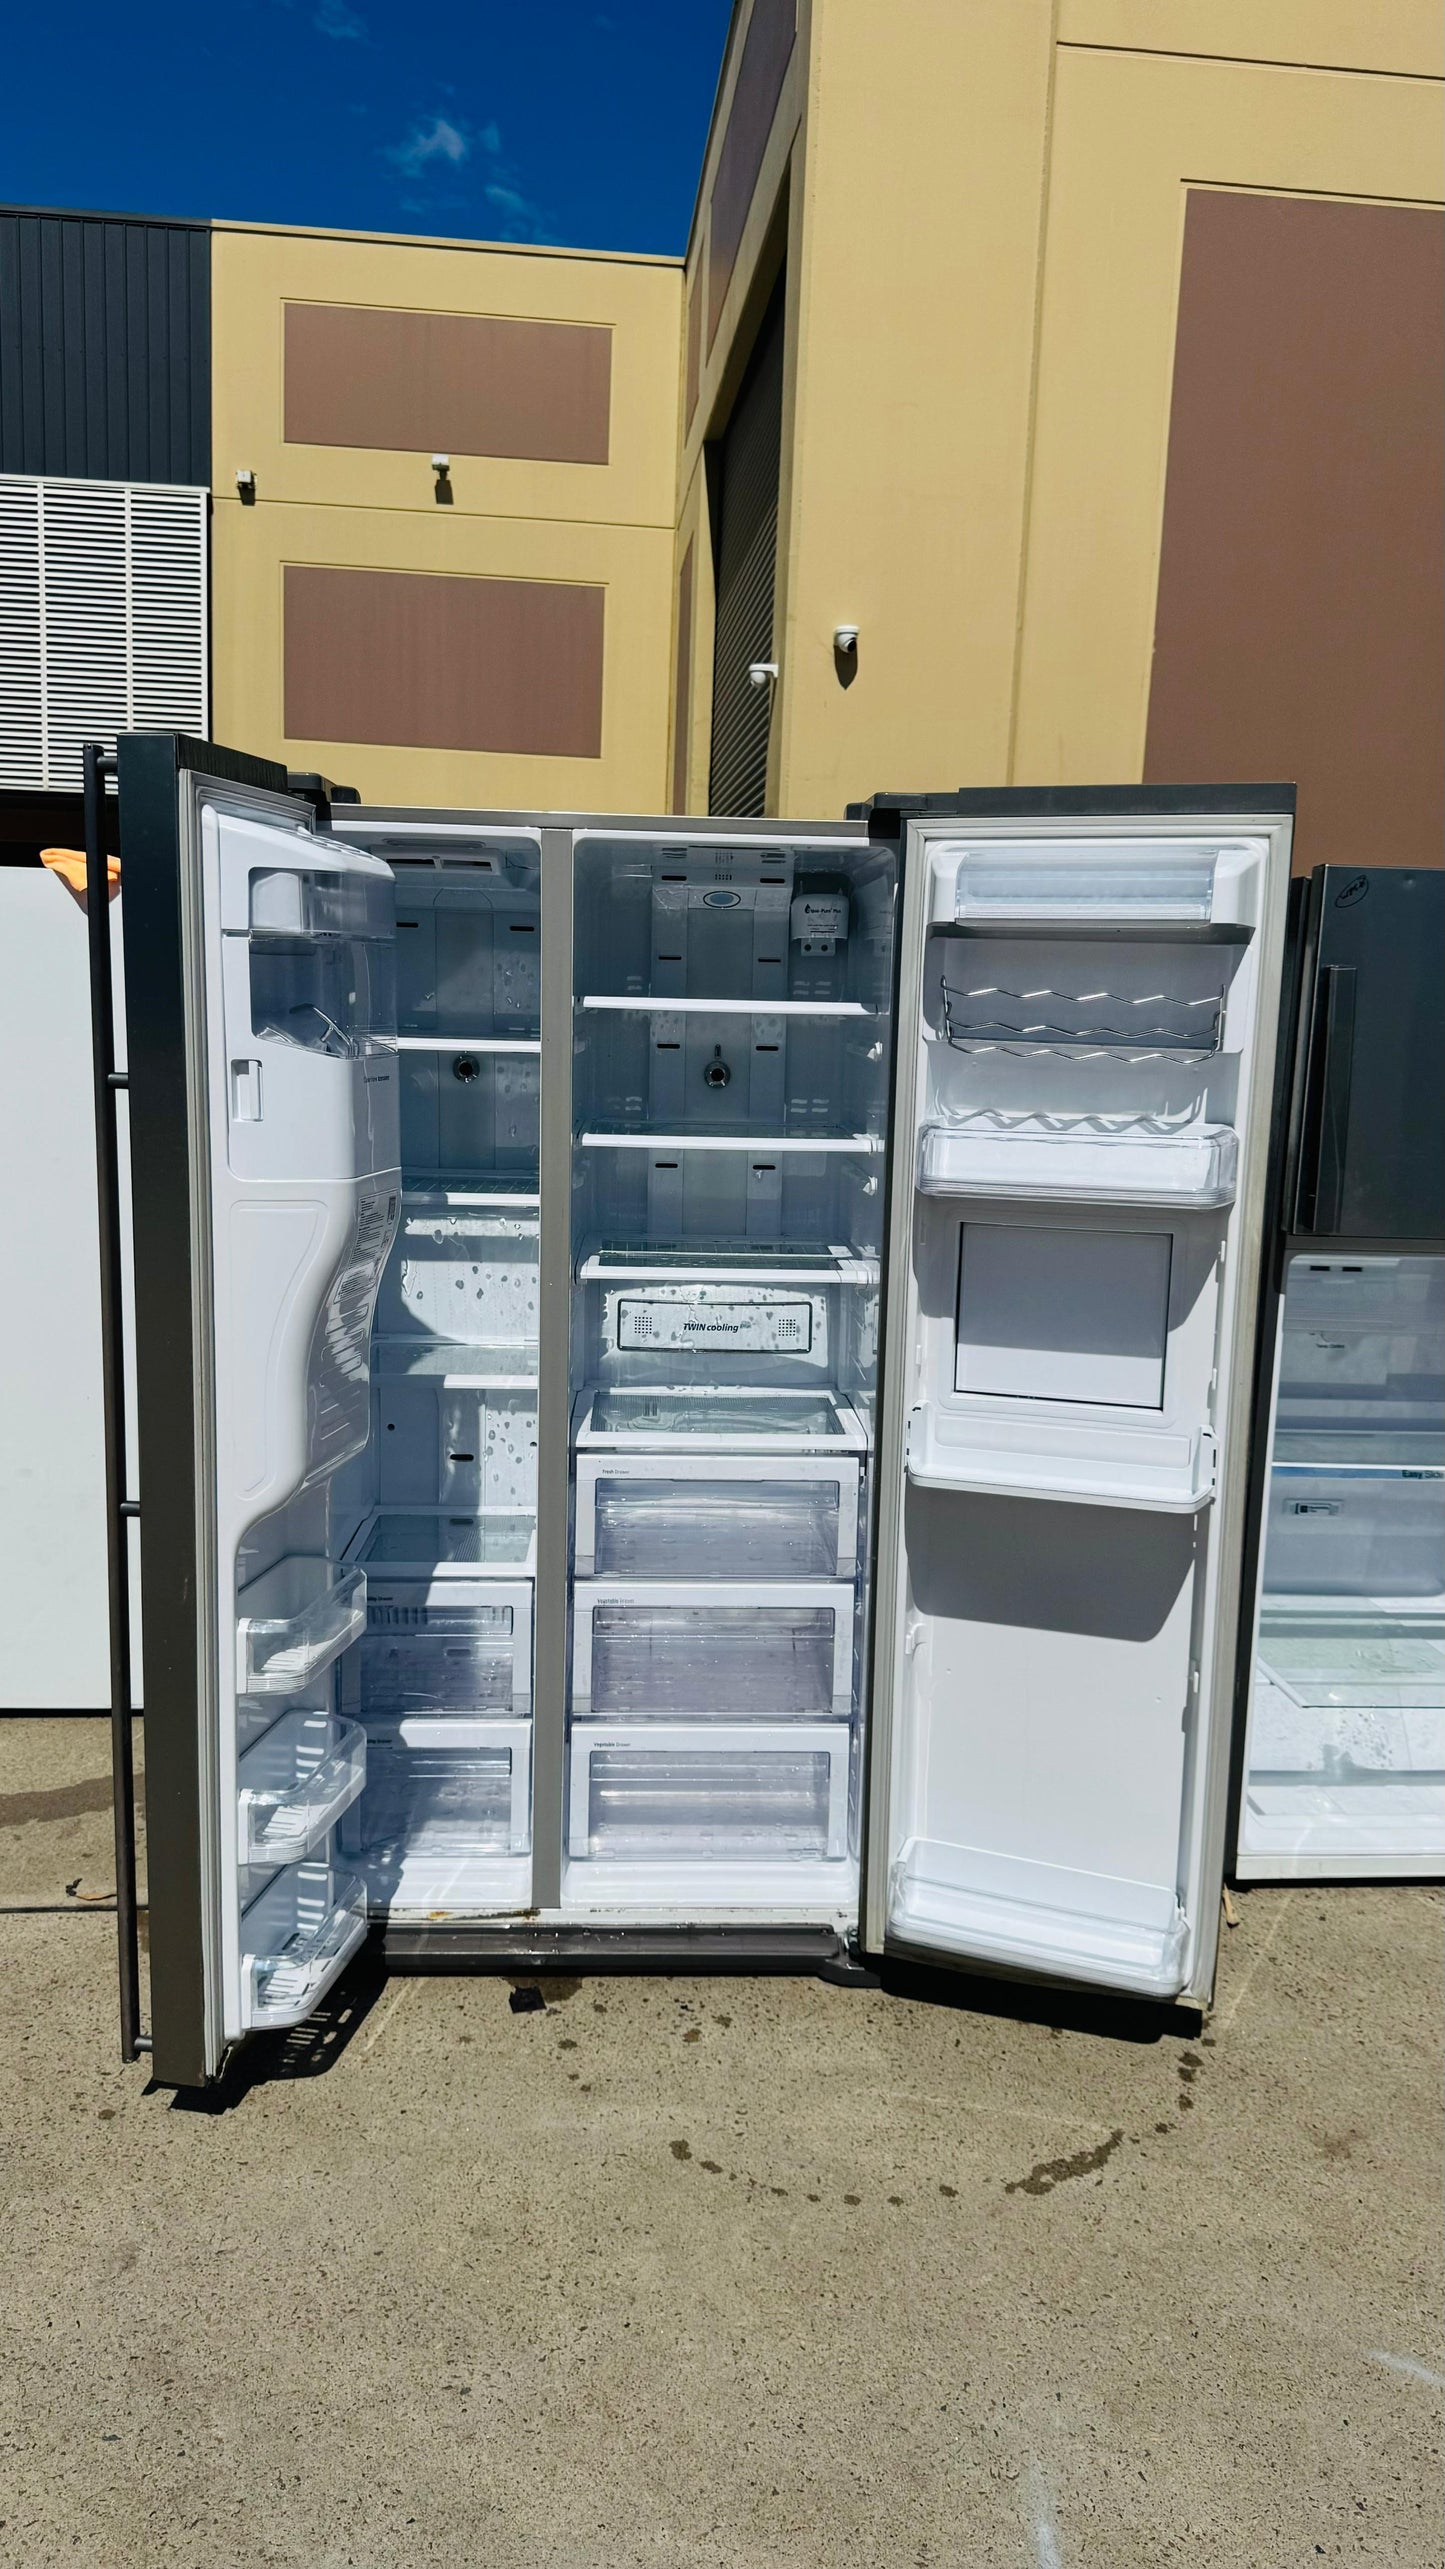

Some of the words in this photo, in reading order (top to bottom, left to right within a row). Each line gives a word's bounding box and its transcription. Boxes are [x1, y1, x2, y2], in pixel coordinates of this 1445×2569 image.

[683, 1322, 706, 1332] TWIN
[706, 1323, 739, 1334] cooling
[1401, 1469, 1423, 1480] Easy
